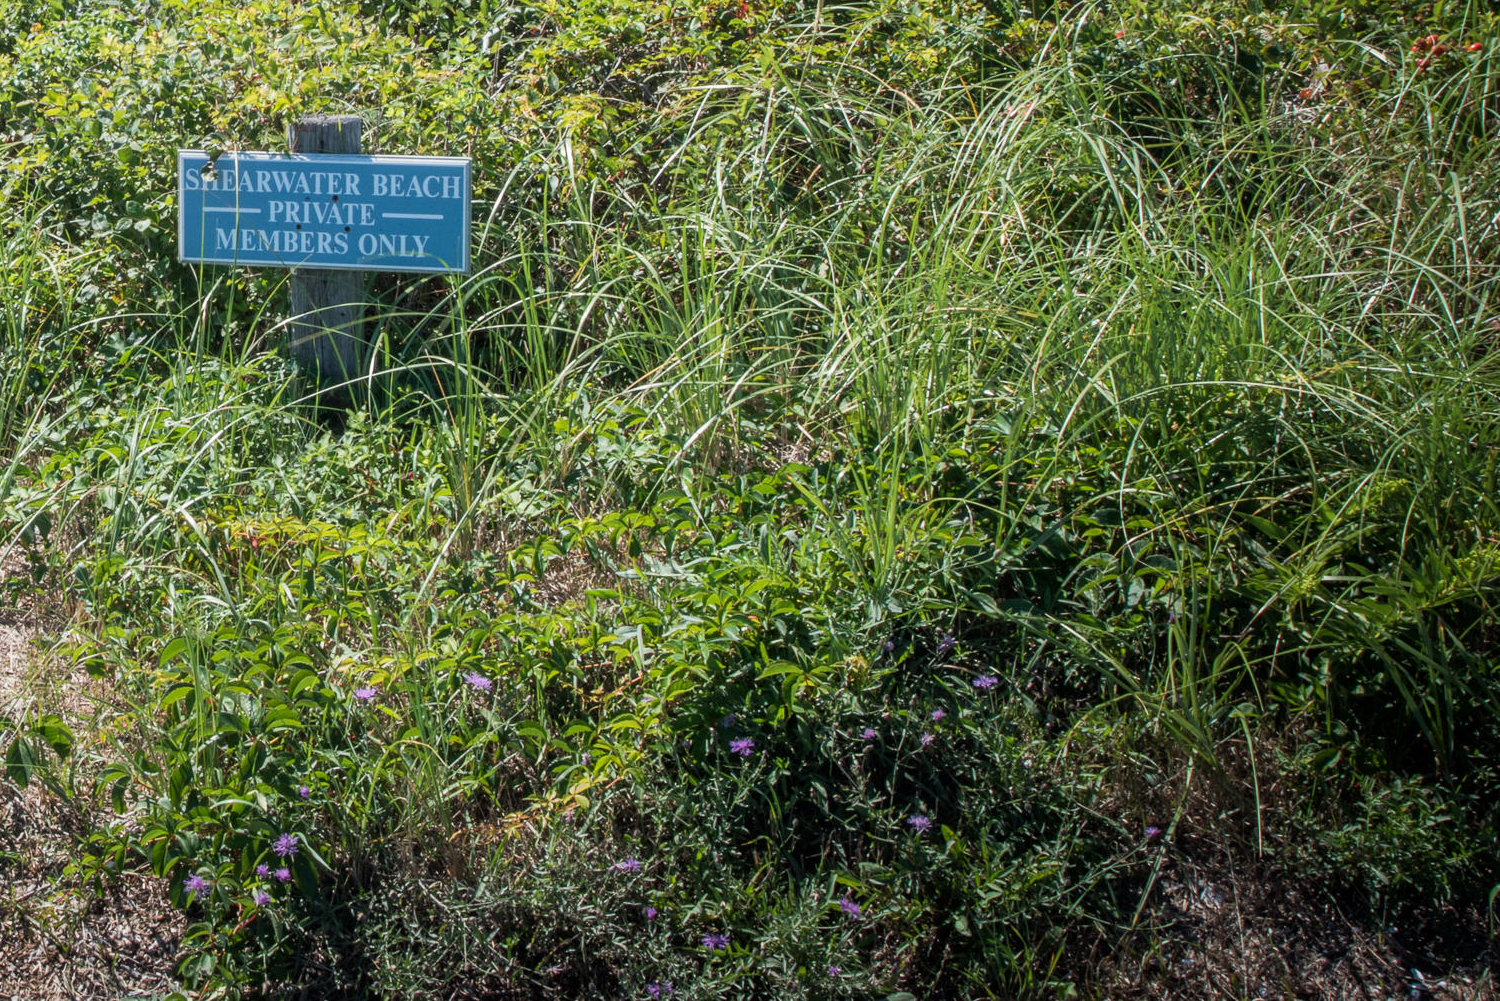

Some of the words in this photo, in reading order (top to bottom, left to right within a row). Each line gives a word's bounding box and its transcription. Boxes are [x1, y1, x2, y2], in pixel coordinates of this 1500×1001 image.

[372, 174, 461, 199] BEACH
[268, 201, 375, 226] PRIVATE
[215, 228, 349, 255] MEMBERS
[358, 233, 430, 257] ONLY
